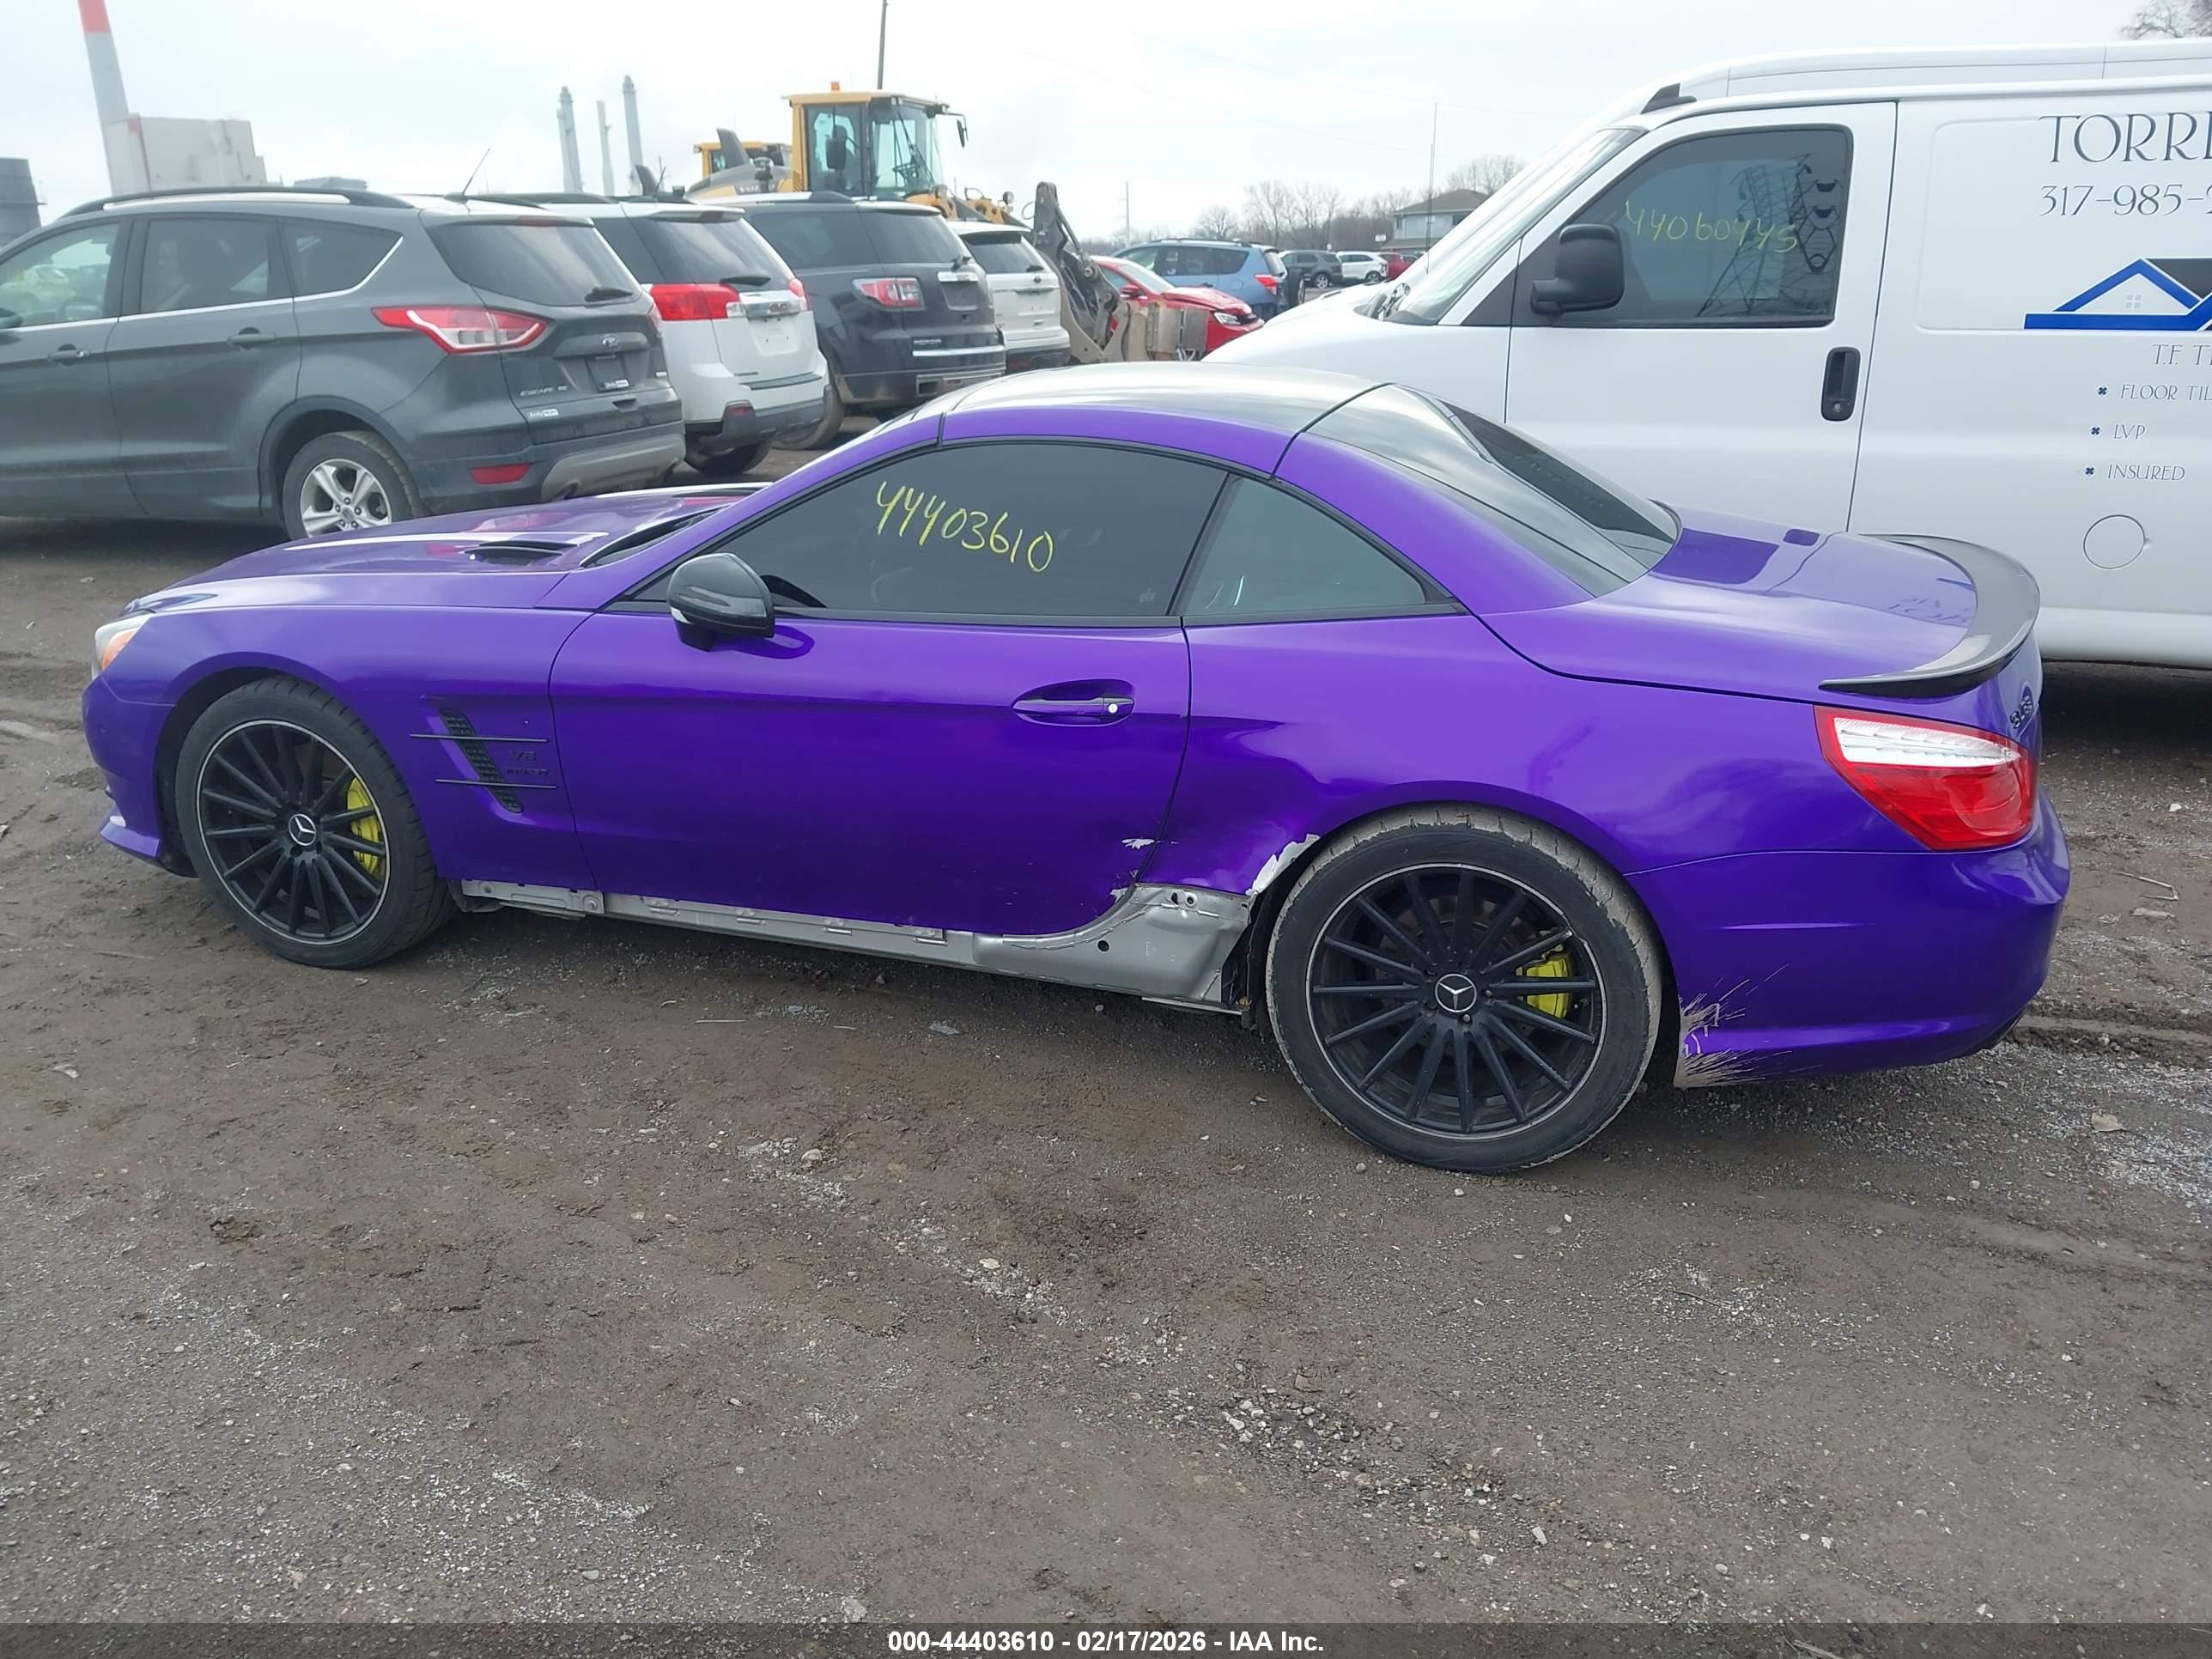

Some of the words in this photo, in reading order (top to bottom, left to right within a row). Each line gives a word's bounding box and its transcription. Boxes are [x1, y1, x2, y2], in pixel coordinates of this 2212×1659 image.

[2151, 343, 2184, 365] T.F.
[2192, 344, 2212, 366] T
[2120, 384, 2179, 401] FLOOR
[2113, 423, 2146, 440] LVP
[2107, 464, 2186, 481] INSURED
[877, 481, 1054, 572] 44403610
